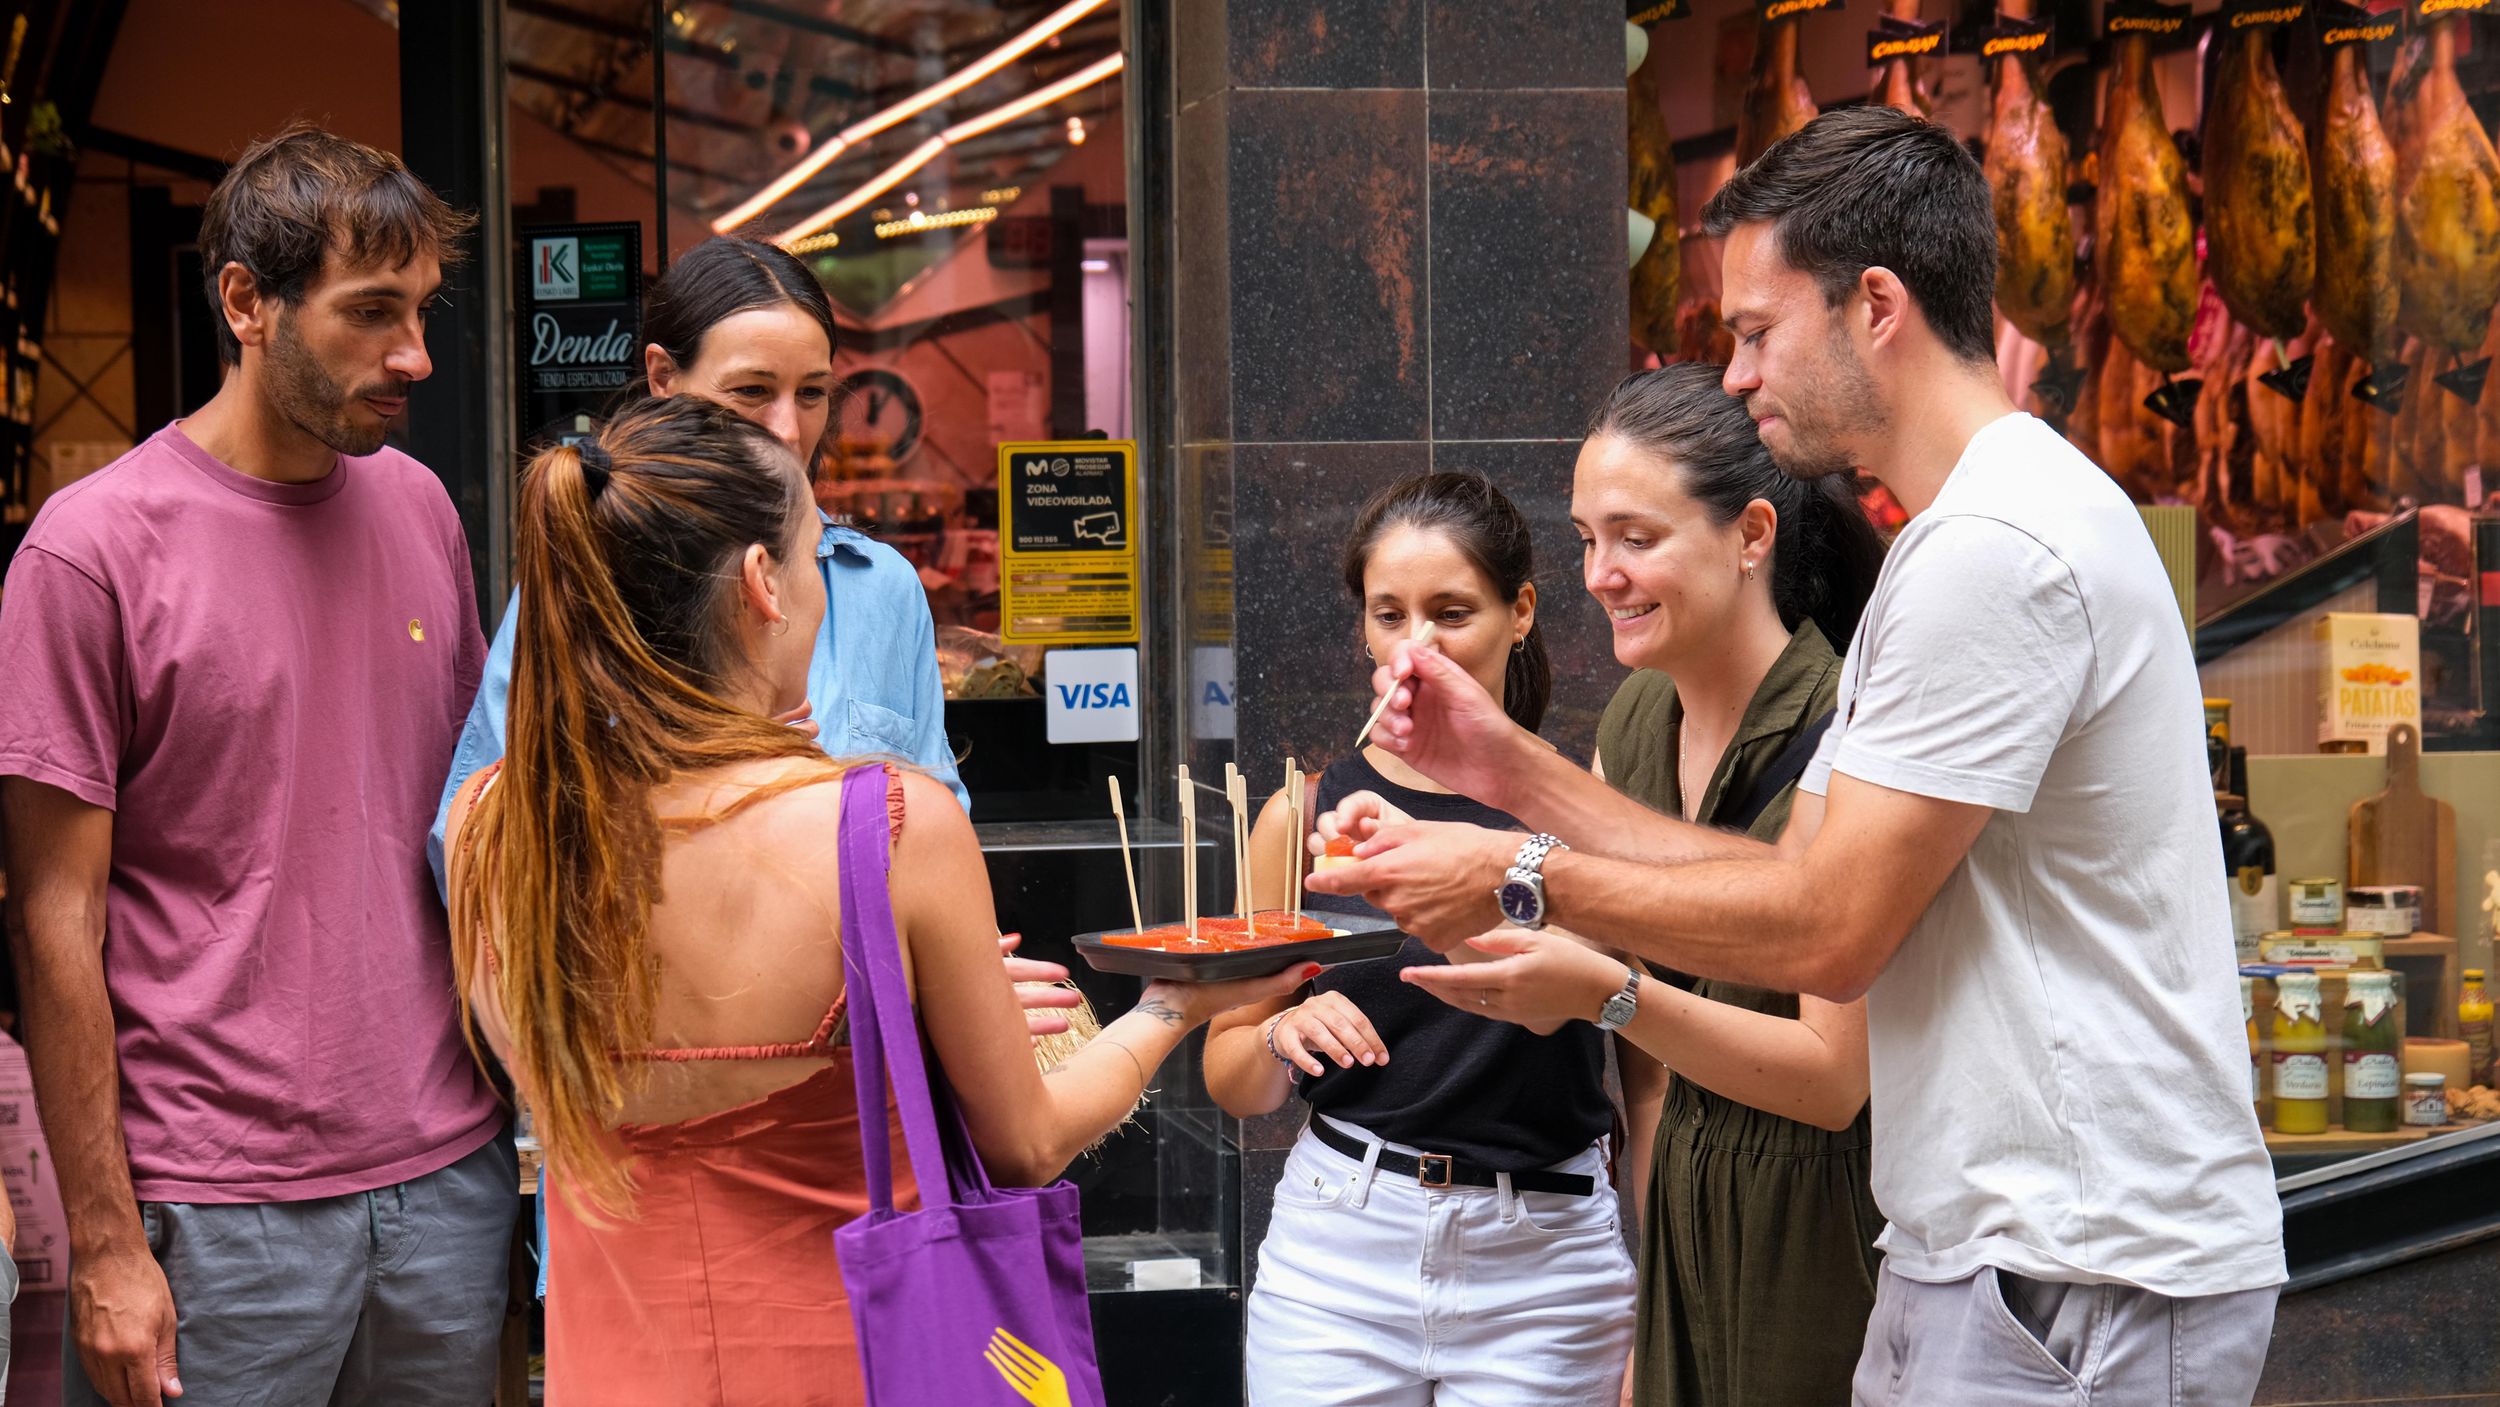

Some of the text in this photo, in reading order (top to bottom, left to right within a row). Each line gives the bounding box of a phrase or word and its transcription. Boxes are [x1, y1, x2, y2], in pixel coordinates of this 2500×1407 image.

[1766, 0, 1829, 20] CARDISA
[2231, 7, 2303, 28] CARDISAN
[2109, 16, 2182, 33] CARDISAN
[2324, 24, 2395, 45] CARDISAN
[1872, 32, 1941, 59] CARDISAN
[1983, 32, 2048, 56] CARDISAN
[531, 312, 634, 366] Denda
[1026, 484, 1058, 494] ZONA
[1026, 496, 1112, 507] VIDEOVIGILADA
[1054, 682, 1131, 710] VISA
[2340, 687, 2416, 719] PATATAS
